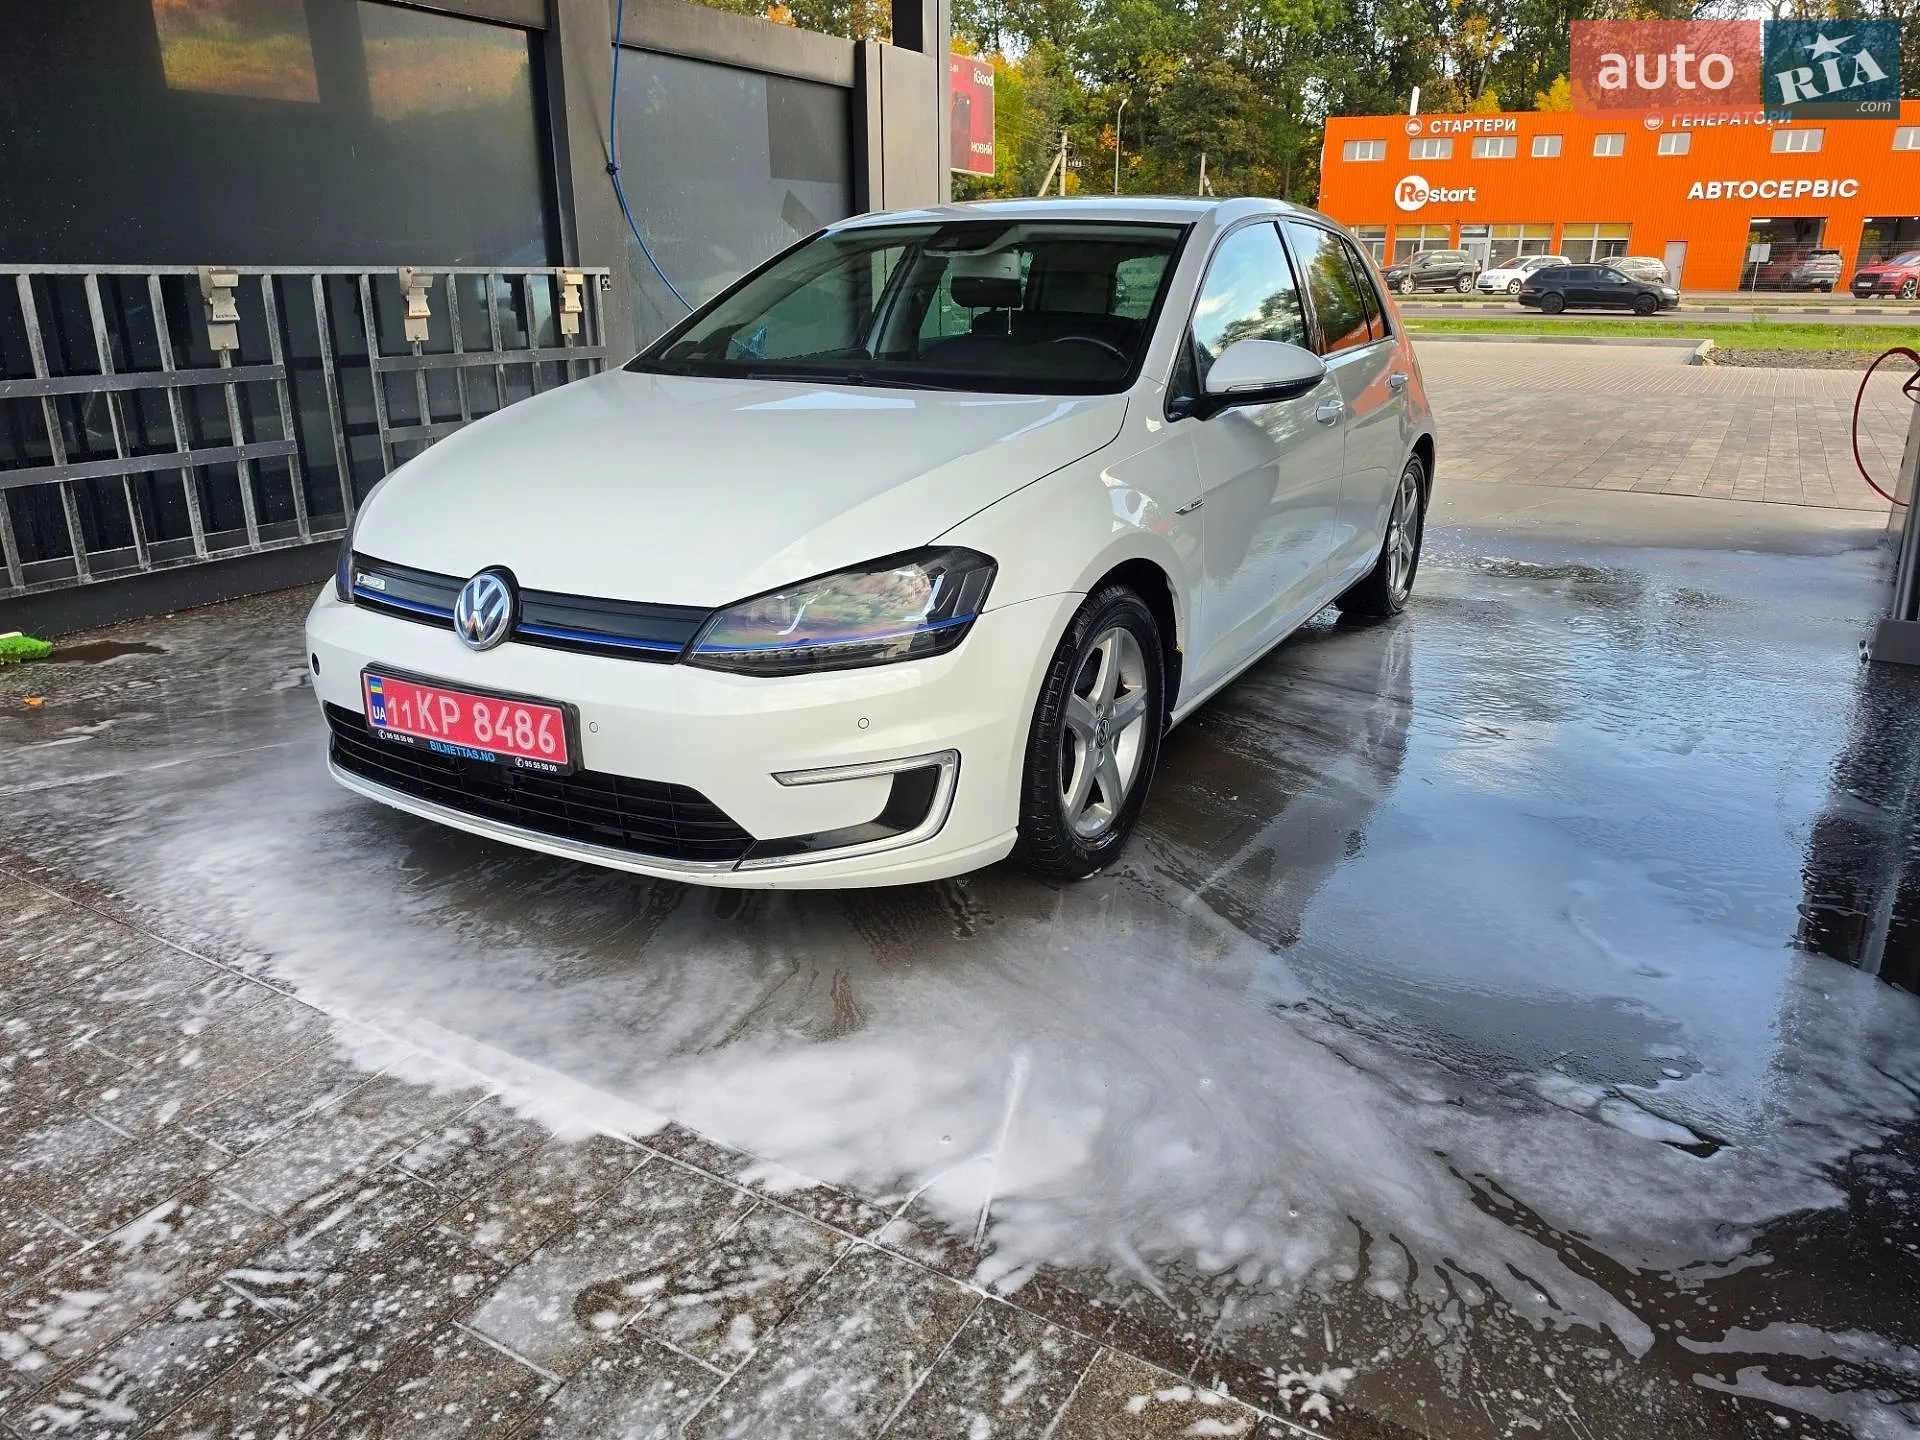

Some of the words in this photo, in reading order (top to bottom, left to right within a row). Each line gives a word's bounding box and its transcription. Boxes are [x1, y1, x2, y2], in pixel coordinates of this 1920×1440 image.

[973, 67, 993, 87] iGood
[1430, 119, 1517, 133] СТАРТЕРИ
[1671, 110, 1793, 128] ГЕНЕРАТОРИ
[1399, 182, 1477, 203] Restart
[1687, 178, 1859, 200] АВТОСЕРВІС
[372, 706, 386, 721] UA
[472, 702, 556, 754] 8486
[429, 741, 496, 763] BILNETTAS.NO
